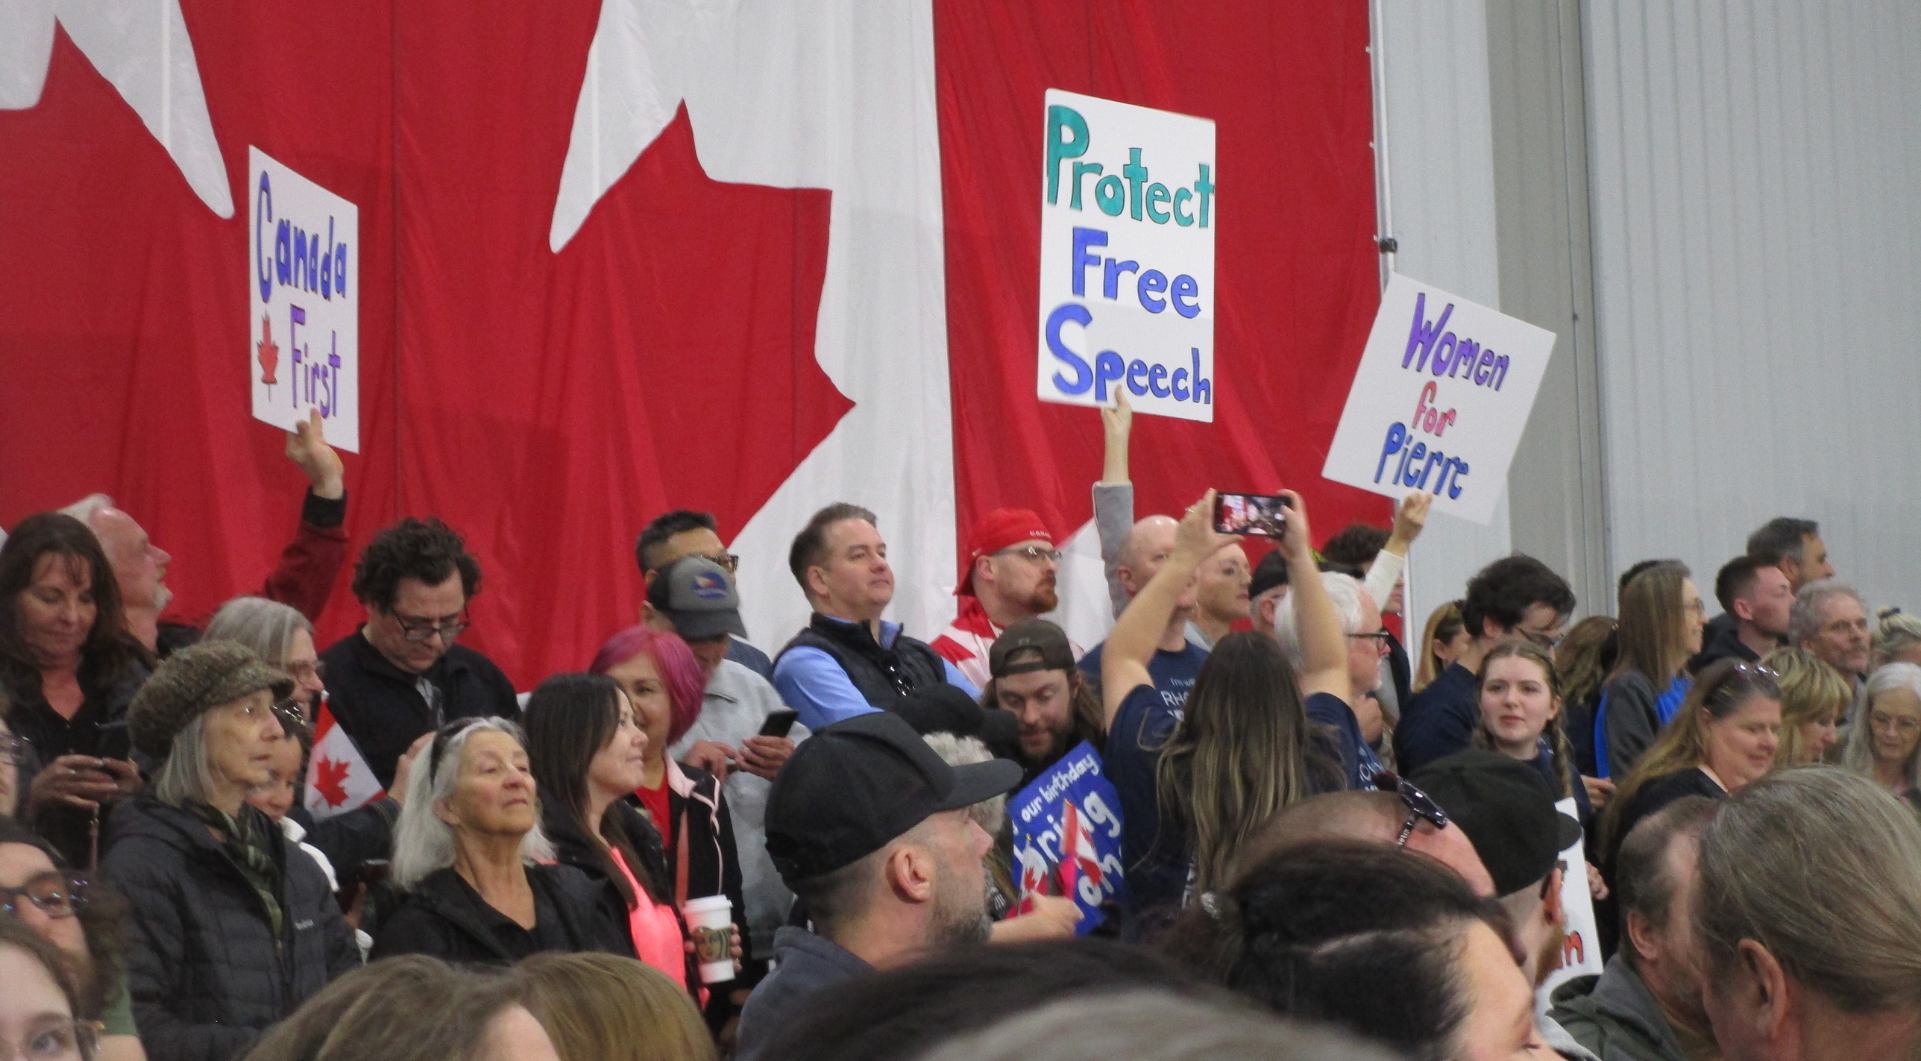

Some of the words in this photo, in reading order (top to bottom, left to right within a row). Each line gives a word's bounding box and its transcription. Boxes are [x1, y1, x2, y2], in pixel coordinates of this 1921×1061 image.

[1047, 104, 1215, 229] Protect
[256, 170, 347, 304] Canada
[1071, 226, 1202, 319] Free
[289, 303, 341, 418] First
[1046, 302, 1211, 405] Speech
[1401, 291, 1511, 392] Women
[1411, 380, 1457, 437] for
[1373, 421, 1470, 500] Pierre
[1021, 795, 1043, 823] our
[1038, 753, 1100, 804] birthday
